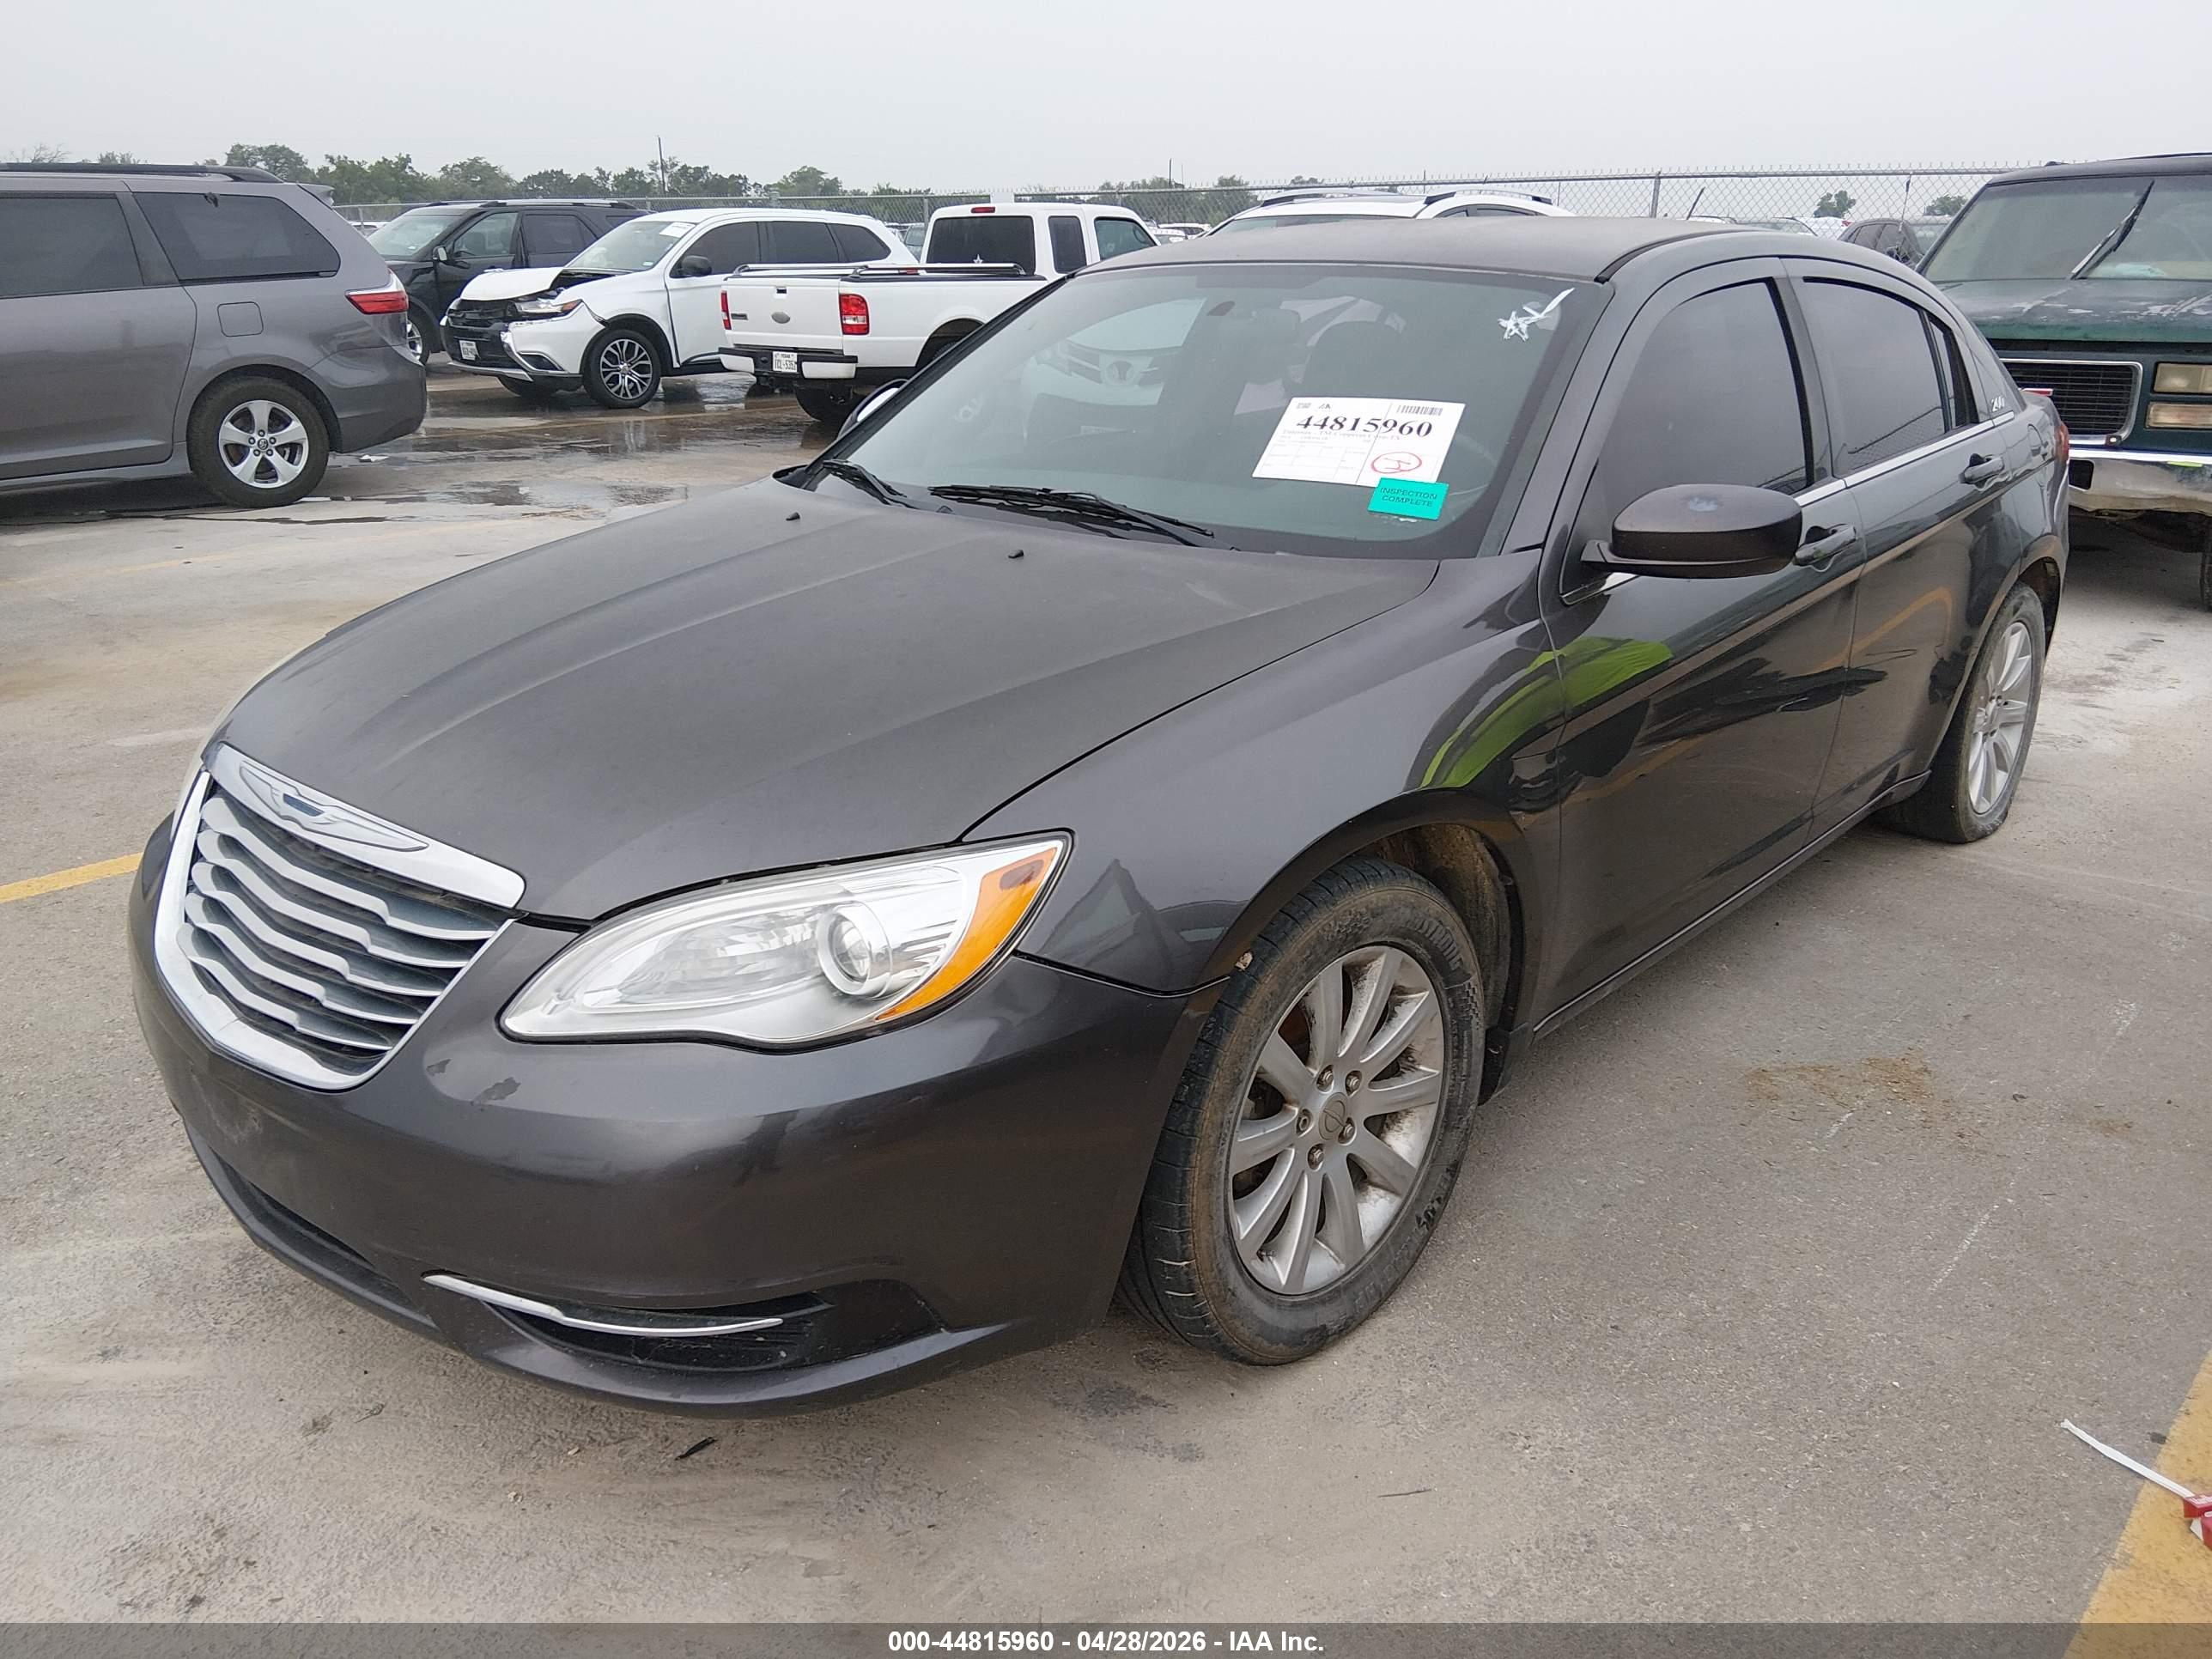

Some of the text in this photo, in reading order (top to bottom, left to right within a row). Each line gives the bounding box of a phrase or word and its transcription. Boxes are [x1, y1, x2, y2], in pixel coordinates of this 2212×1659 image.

[1297, 415, 1432, 438] 44815960
[1380, 487, 1437, 500] INSPECTION
[1381, 495, 1434, 507] COMPLETE
